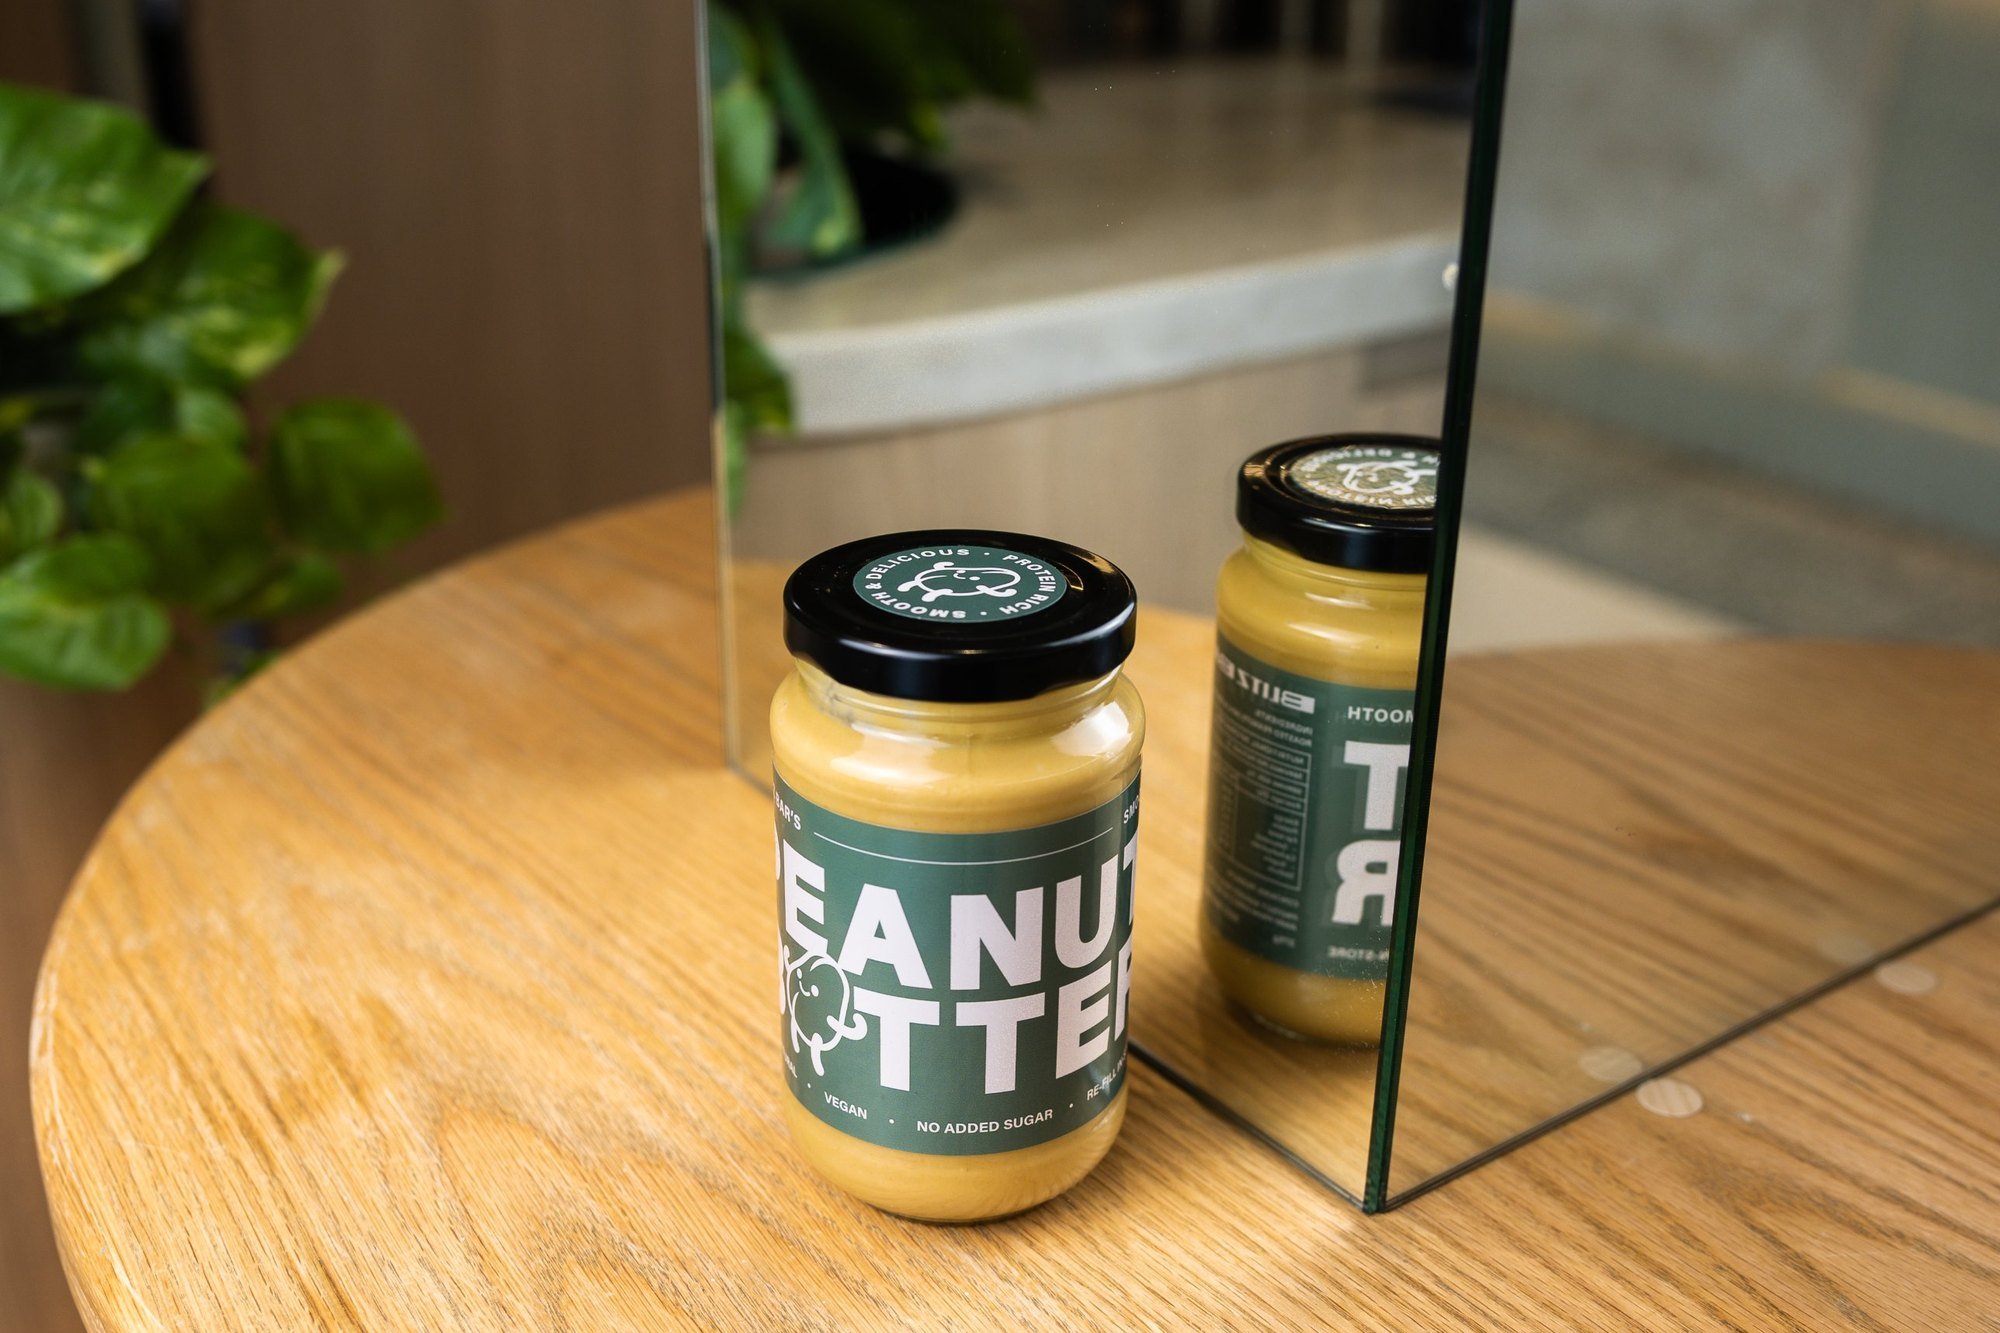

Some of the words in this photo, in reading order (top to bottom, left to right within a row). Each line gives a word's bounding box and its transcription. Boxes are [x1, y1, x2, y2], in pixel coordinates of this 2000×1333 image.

[865, 548, 970, 580] DELICIOUS
[1002, 554, 1057, 592] PROTEIN
[865, 582, 882, 590] &
[871, 591, 967, 619] SMOOTH
[999, 593, 1050, 615] RICH
[774, 822, 1139, 992] EANUT
[824, 1091, 868, 1120] VEGAN
[916, 1120, 941, 1134] NO
[944, 1121, 1000, 1135] ADDED
[1003, 1108, 1054, 1131] SUGAR
